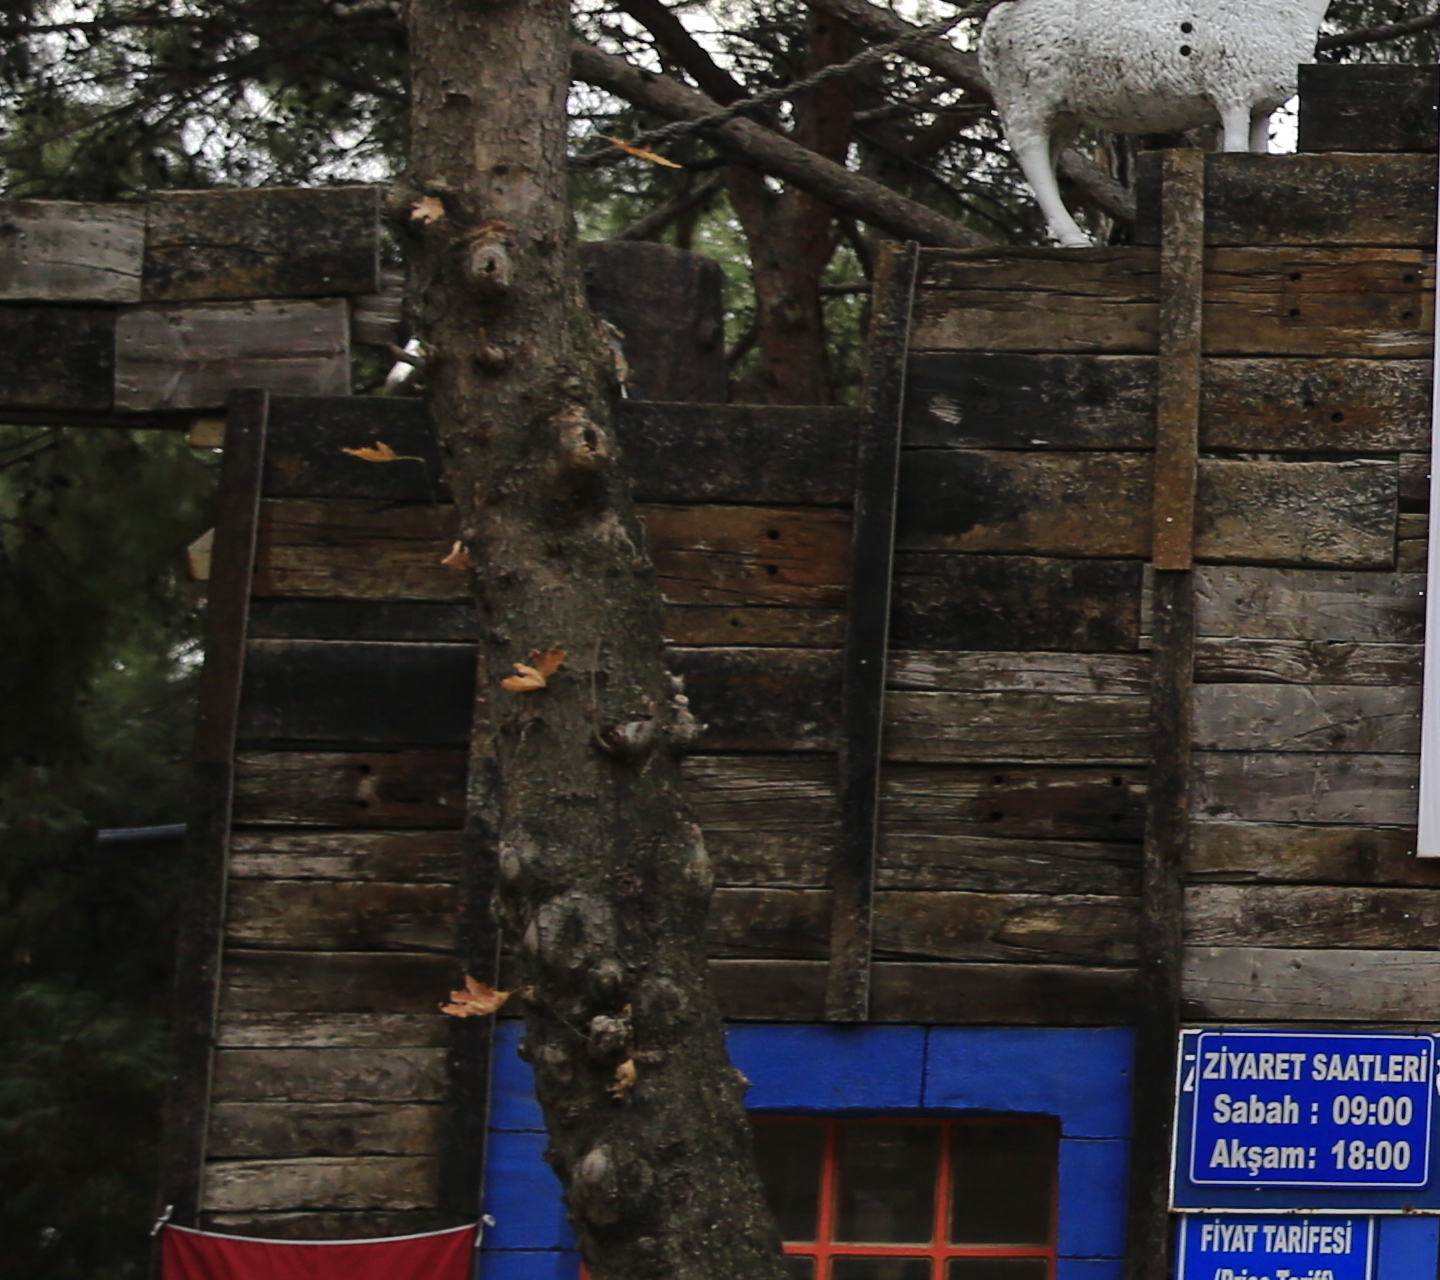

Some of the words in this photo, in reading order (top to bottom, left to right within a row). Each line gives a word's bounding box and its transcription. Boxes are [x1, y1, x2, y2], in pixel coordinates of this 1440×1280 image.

[1202, 1046, 1306, 1080] ZİYARET
[1311, 1049, 1428, 1083] SAATLERİ
[1212, 1093, 1300, 1124] Sabah
[1332, 1095, 1413, 1126] 09:00
[1331, 1140, 1411, 1170] 18:00
[1200, 1218, 1258, 1253] FİYAT
[1263, 1220, 1352, 1255] TARİFESİ
